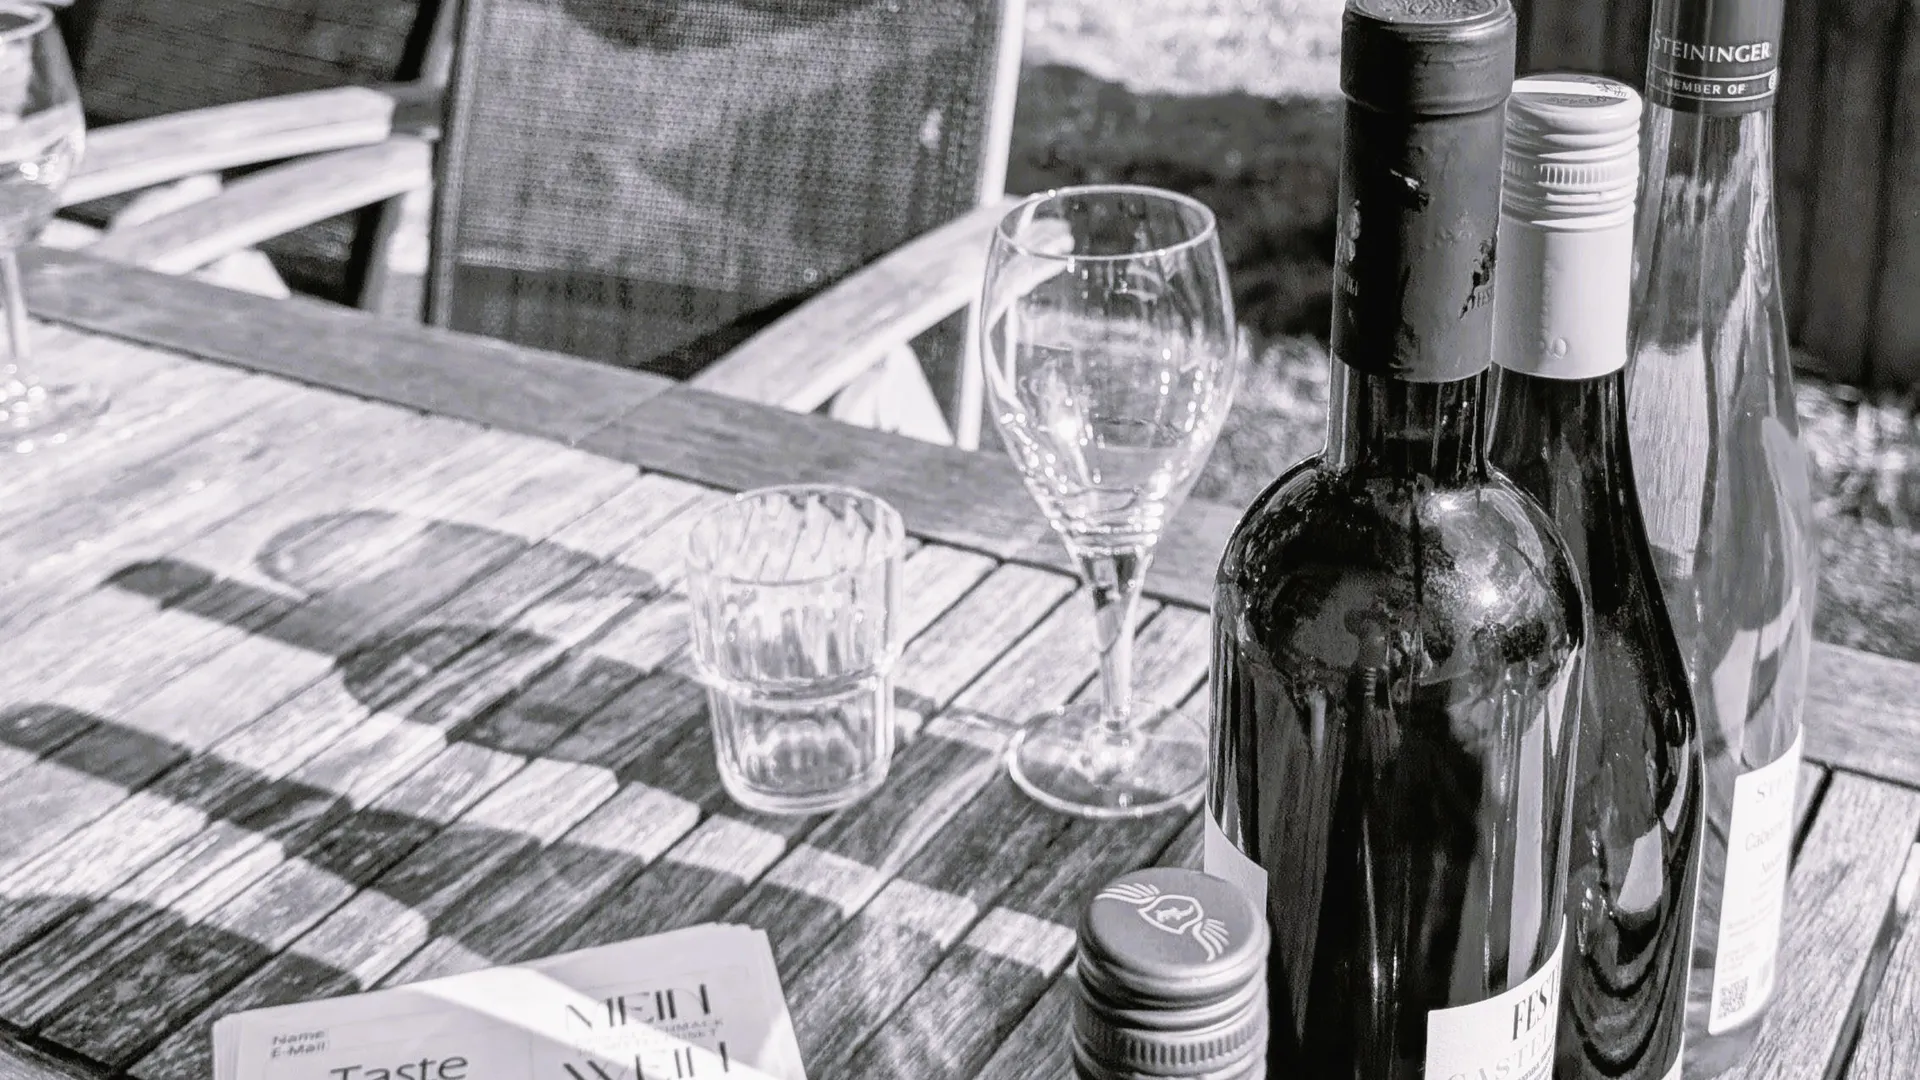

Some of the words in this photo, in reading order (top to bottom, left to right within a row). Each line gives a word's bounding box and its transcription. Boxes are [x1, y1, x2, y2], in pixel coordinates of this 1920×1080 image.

[1653, 28, 1772, 63] STEININGER
[1665, 77, 1721, 95] MEMBER
[1727, 83, 1747, 95] OF
[566, 983, 711, 1028] MEIN
